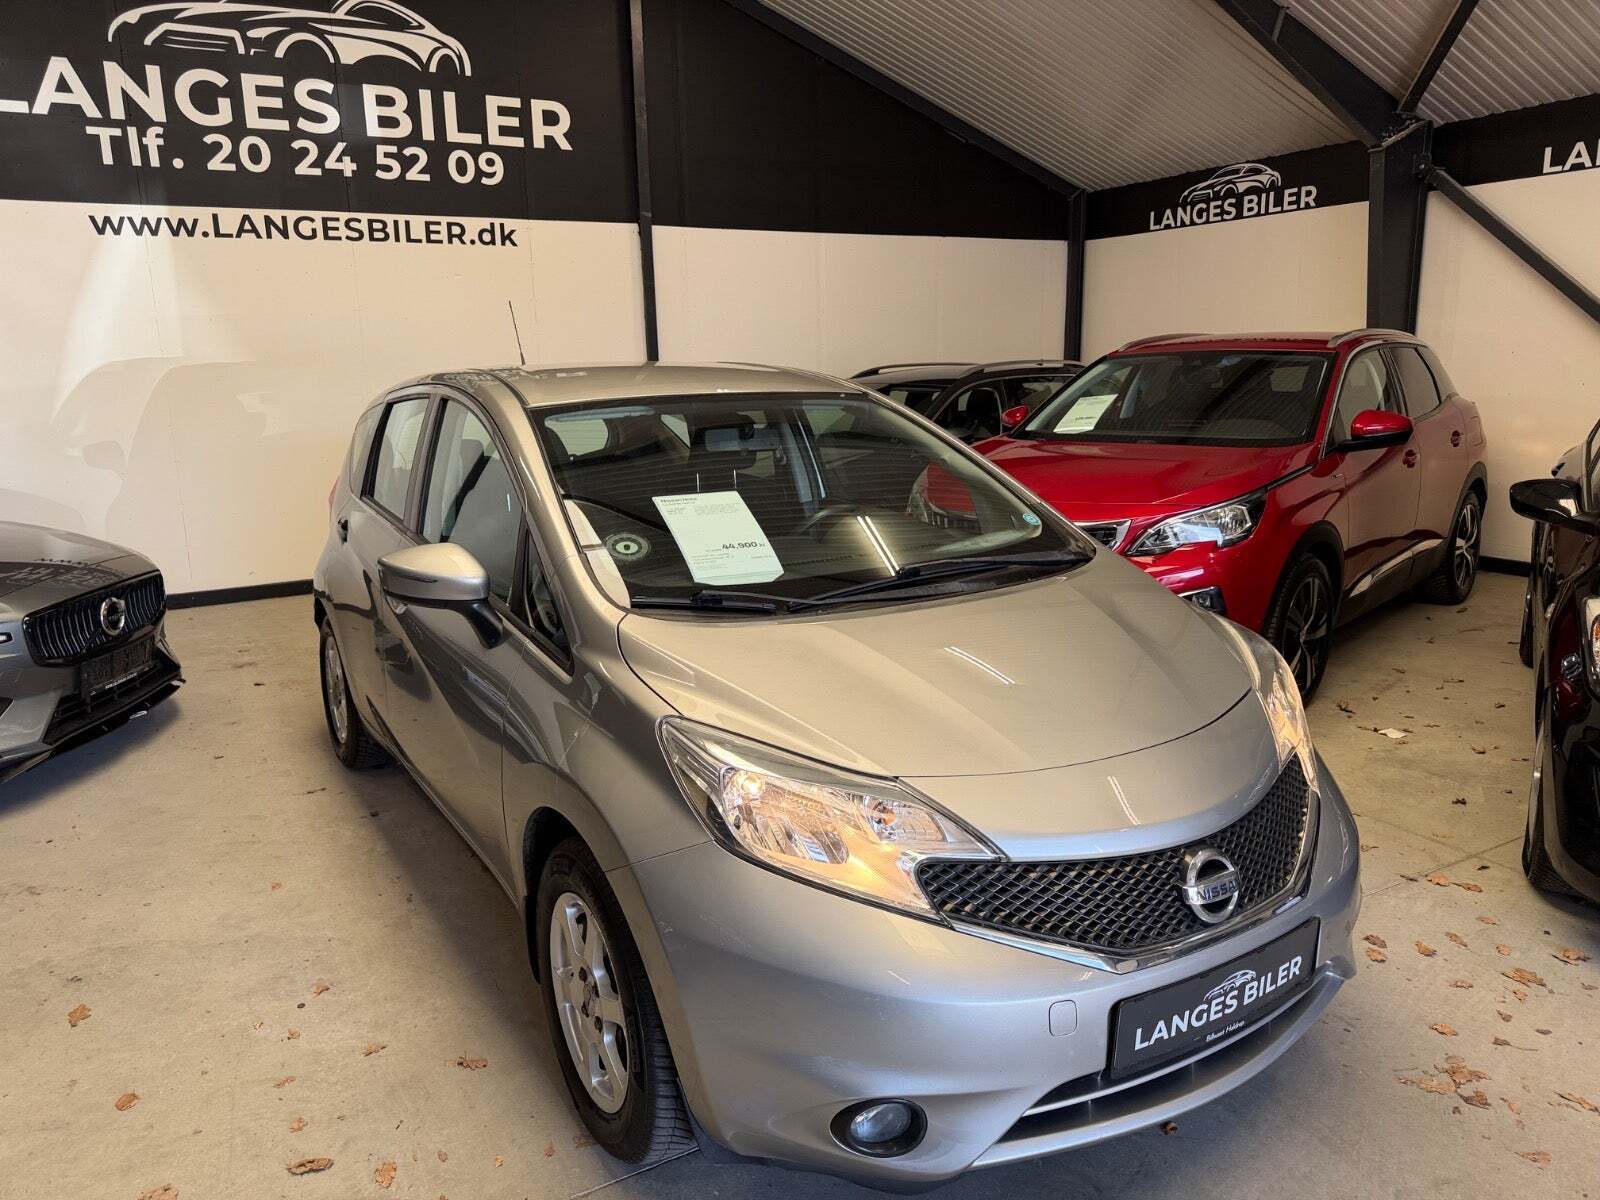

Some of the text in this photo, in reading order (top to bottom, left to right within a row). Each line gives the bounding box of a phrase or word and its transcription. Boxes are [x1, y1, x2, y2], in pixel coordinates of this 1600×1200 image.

[362, 83, 573, 151] BILER
[85, 125, 505, 186] Tlf. 20 24 52 09
[1543, 138, 1600, 174] LA
[88, 212, 519, 248] www.LANGESBILER.dk
[1149, 185, 1318, 231] LANGES BILER
[1134, 955, 1302, 1051] LANGES BILER
